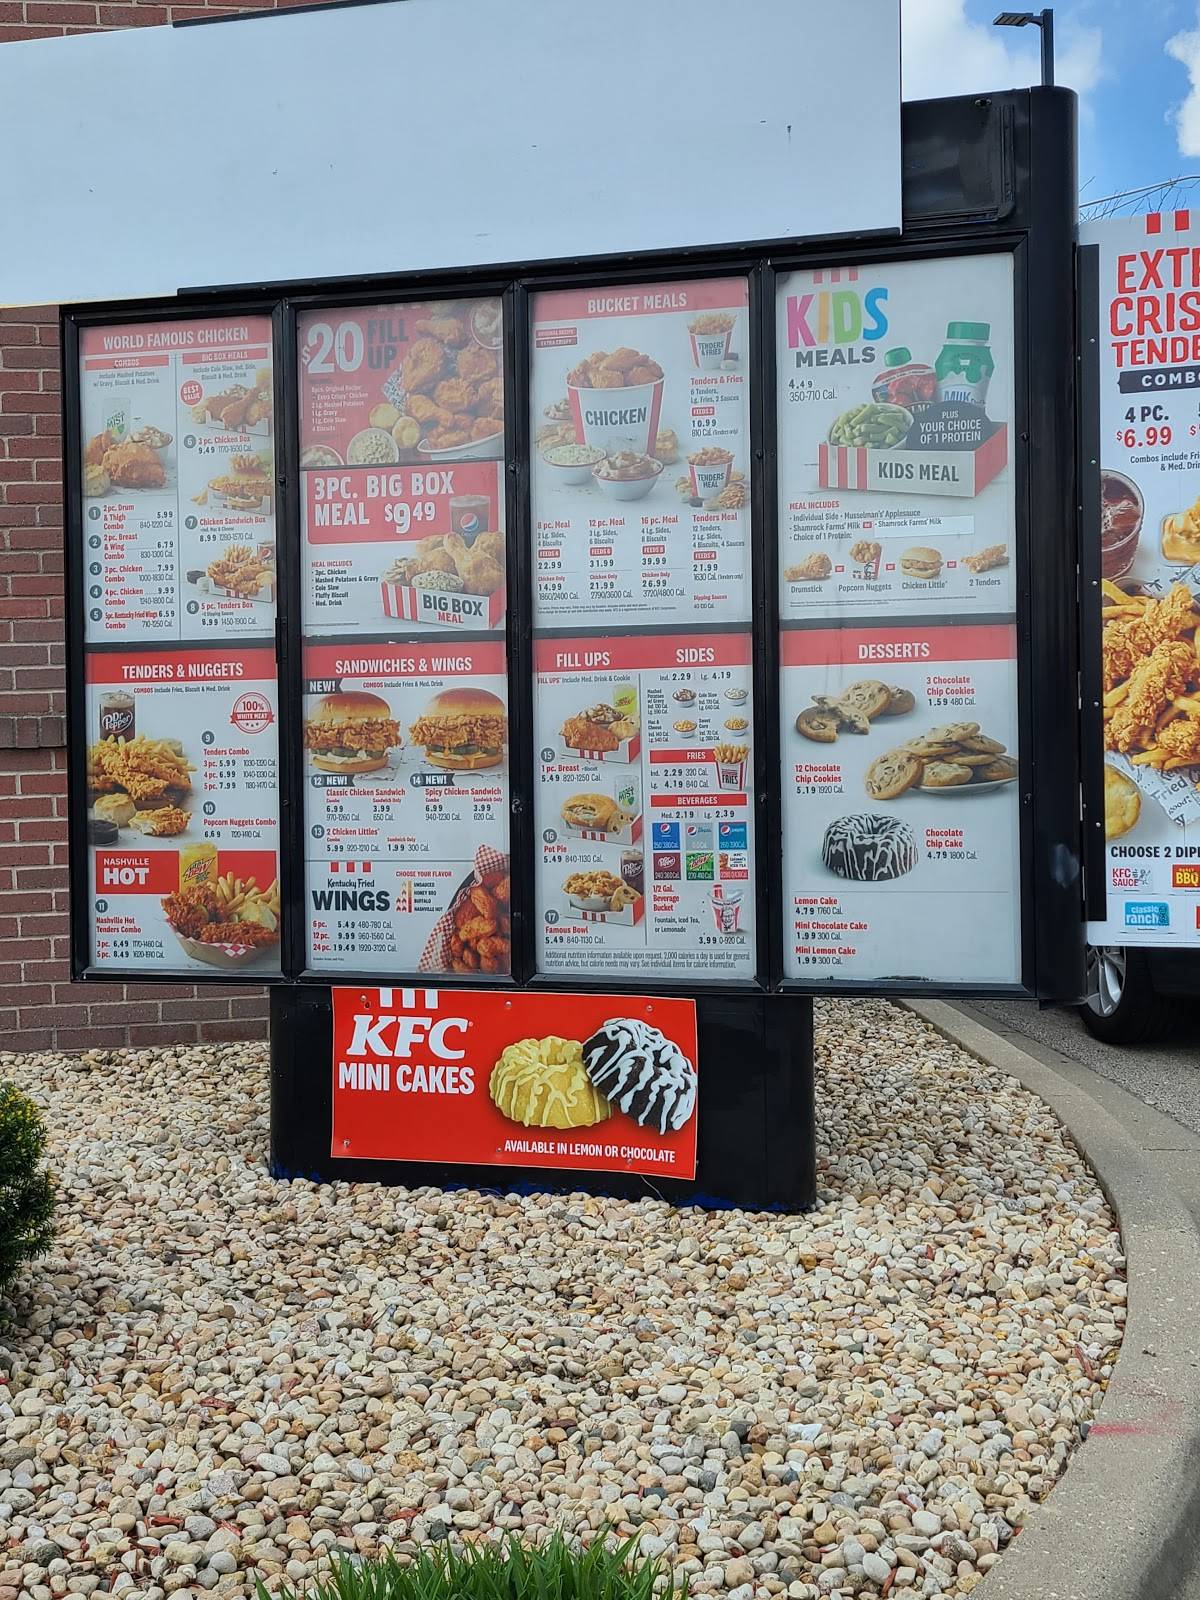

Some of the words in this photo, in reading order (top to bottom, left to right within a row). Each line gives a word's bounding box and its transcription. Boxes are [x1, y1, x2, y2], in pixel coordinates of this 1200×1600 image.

[588, 297, 639, 314] BUCKET
[644, 293, 687, 309] MEALS
[787, 287, 889, 349] KIDS
[368, 319, 409, 342] FILL
[103, 335, 143, 350] WORLD
[147, 331, 194, 347] FAMOUS
[197, 327, 248, 343] CHICKEN
[368, 345, 397, 369] UP
[795, 346, 875, 368] MEALS
[690, 377, 717, 385] Tenders
[726, 375, 743, 383] Fries
[789, 379, 812, 389] 4.49
[1142, 372, 1200, 387] COMB
[822, 389, 837, 400] Cal.
[585, 408, 647, 426] CHICKEN
[942, 411, 958, 419] PLUS
[1125, 407, 1136, 423] 4
[1141, 405, 1169, 422] PC.
[920, 422, 945, 432] YOUR
[948, 420, 981, 430] CHOICE
[920, 434, 933, 444] OF
[942, 431, 981, 443] PROTEIN
[1116, 427, 1172, 448] $6.99
[1131, 453, 1159, 464] Combos
[1161, 452, 1188, 462] include
[1168, 462, 1185, 470] Med.
[878, 462, 914, 480] KIDS
[919, 464, 959, 482] MEAL
[314, 477, 358, 500] 3PC.
[367, 474, 402, 497] BIG
[411, 471, 454, 496] BOX
[790, 502, 807, 510] MEAL
[808, 500, 839, 508] INCLUDES
[315, 502, 369, 527] MEAL
[793, 513, 823, 521] Individual
[885, 510, 920, 518] Applesauce
[224, 517, 253, 525] Sandwich
[793, 533, 813, 541] Choice
[590, 582, 614, 590] 21.99
[838, 584, 864, 592] Popcorn
[866, 583, 891, 591] Nuggets
[902, 581, 924, 589] Chicken
[975, 578, 1000, 587] Tenders
[791, 585, 822, 593] Drumstick
[423, 594, 448, 612] BIG
[452, 599, 483, 616] BOX
[438, 612, 464, 624] MEAL
[676, 648, 714, 662] SIDES
[859, 643, 930, 659] DESSERTS
[556, 653, 581, 667] FILL
[584, 652, 612, 666] UPS
[335, 659, 415, 674] SANDWICHES
[419, 659, 427, 672] &
[432, 657, 472, 672] WINGS
[122, 665, 173, 679] TENDERS
[177, 665, 185, 677] &
[189, 663, 243, 677] NUGGETS
[672, 673, 691, 681] 2.29
[932, 675, 970, 684] Chocolate
[310, 680, 336, 692] NEW!
[926, 687, 944, 696] Chip
[946, 687, 975, 695] Cookies
[242, 701, 264, 711] 100%
[928, 698, 948, 706] 1.59
[950, 697, 963, 705] 480
[102, 712, 132, 731] Pepper
[112, 712, 124, 723] Dr
[795, 764, 803, 772] 12
[804, 764, 840, 772] Chocolate
[327, 776, 347, 785] NEW!
[413, 776, 421, 784] 14
[426, 775, 447, 784] NEW!
[722, 774, 738, 785] FRIES
[796, 775, 812, 783] Chip
[813, 775, 841, 783] Cookies
[350, 788, 374, 796] Chicken
[375, 788, 405, 796] Sandwich
[425, 788, 442, 796] Spicy
[471, 787, 501, 795] Sandwich
[796, 786, 816, 794] 5.19
[677, 796, 718, 805] BEVERAGES
[327, 805, 343, 813] 6.99
[373, 805, 390, 813] 3.99
[203, 819, 228, 827] Popcorn
[229, 819, 254, 827] Nuggets
[332, 828, 357, 836] Chicken
[925, 828, 963, 837] Chocolate
[944, 840, 963, 848] Cake
[1111, 847, 1160, 857] CHOOSE
[1165, 847, 1171, 857] 2
[103, 868, 149, 885] HOT
[1113, 869, 1131, 878] KFC
[1176, 872, 1199, 884] BBQ
[327, 879, 357, 889] Kentucky
[358, 879, 374, 888] Fried
[312, 891, 390, 911] WINGS
[653, 895, 679, 903] Beverage
[794, 897, 818, 905] Lemon
[820, 897, 837, 905] Cake
[653, 904, 673, 912] Bucket
[1126, 914, 1159, 924] ranch
[545, 926, 571, 934] Famous
[572, 926, 588, 934] Bowl
[346, 1015, 468, 1059] KFC
[339, 1062, 389, 1091] MINI
[397, 1065, 475, 1094] CAKES
[505, 1140, 555, 1154] AVAILABLE
[557, 1144, 567, 1154] IN
[570, 1145, 602, 1157] LEMON
[605, 1146, 618, 1158] OR
[621, 1147, 675, 1162] CHOCOLATE
